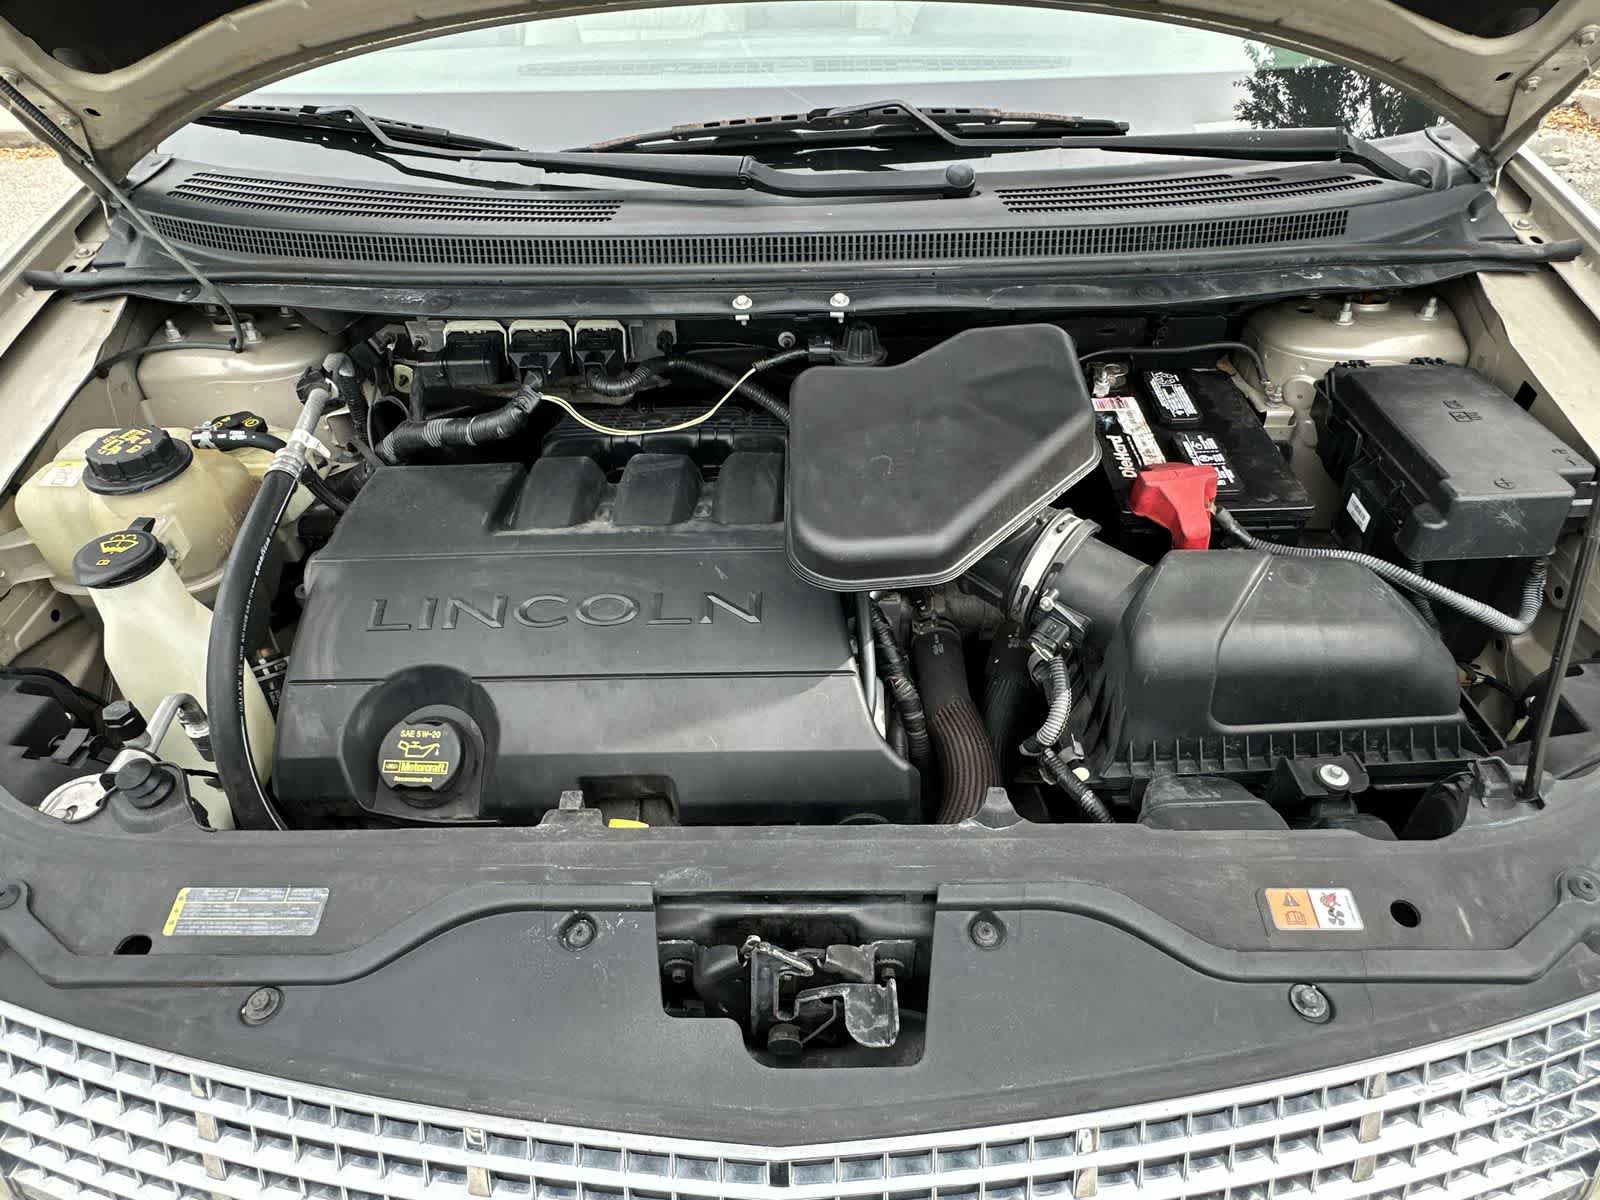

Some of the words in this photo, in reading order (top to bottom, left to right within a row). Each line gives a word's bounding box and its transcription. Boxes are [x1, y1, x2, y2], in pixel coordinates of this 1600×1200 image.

[1106, 435, 1138, 478] DieHard
[366, 592, 762, 632] LINCOLN
[400, 729, 415, 738] SAE
[416, 730, 441, 739] 5W-20
